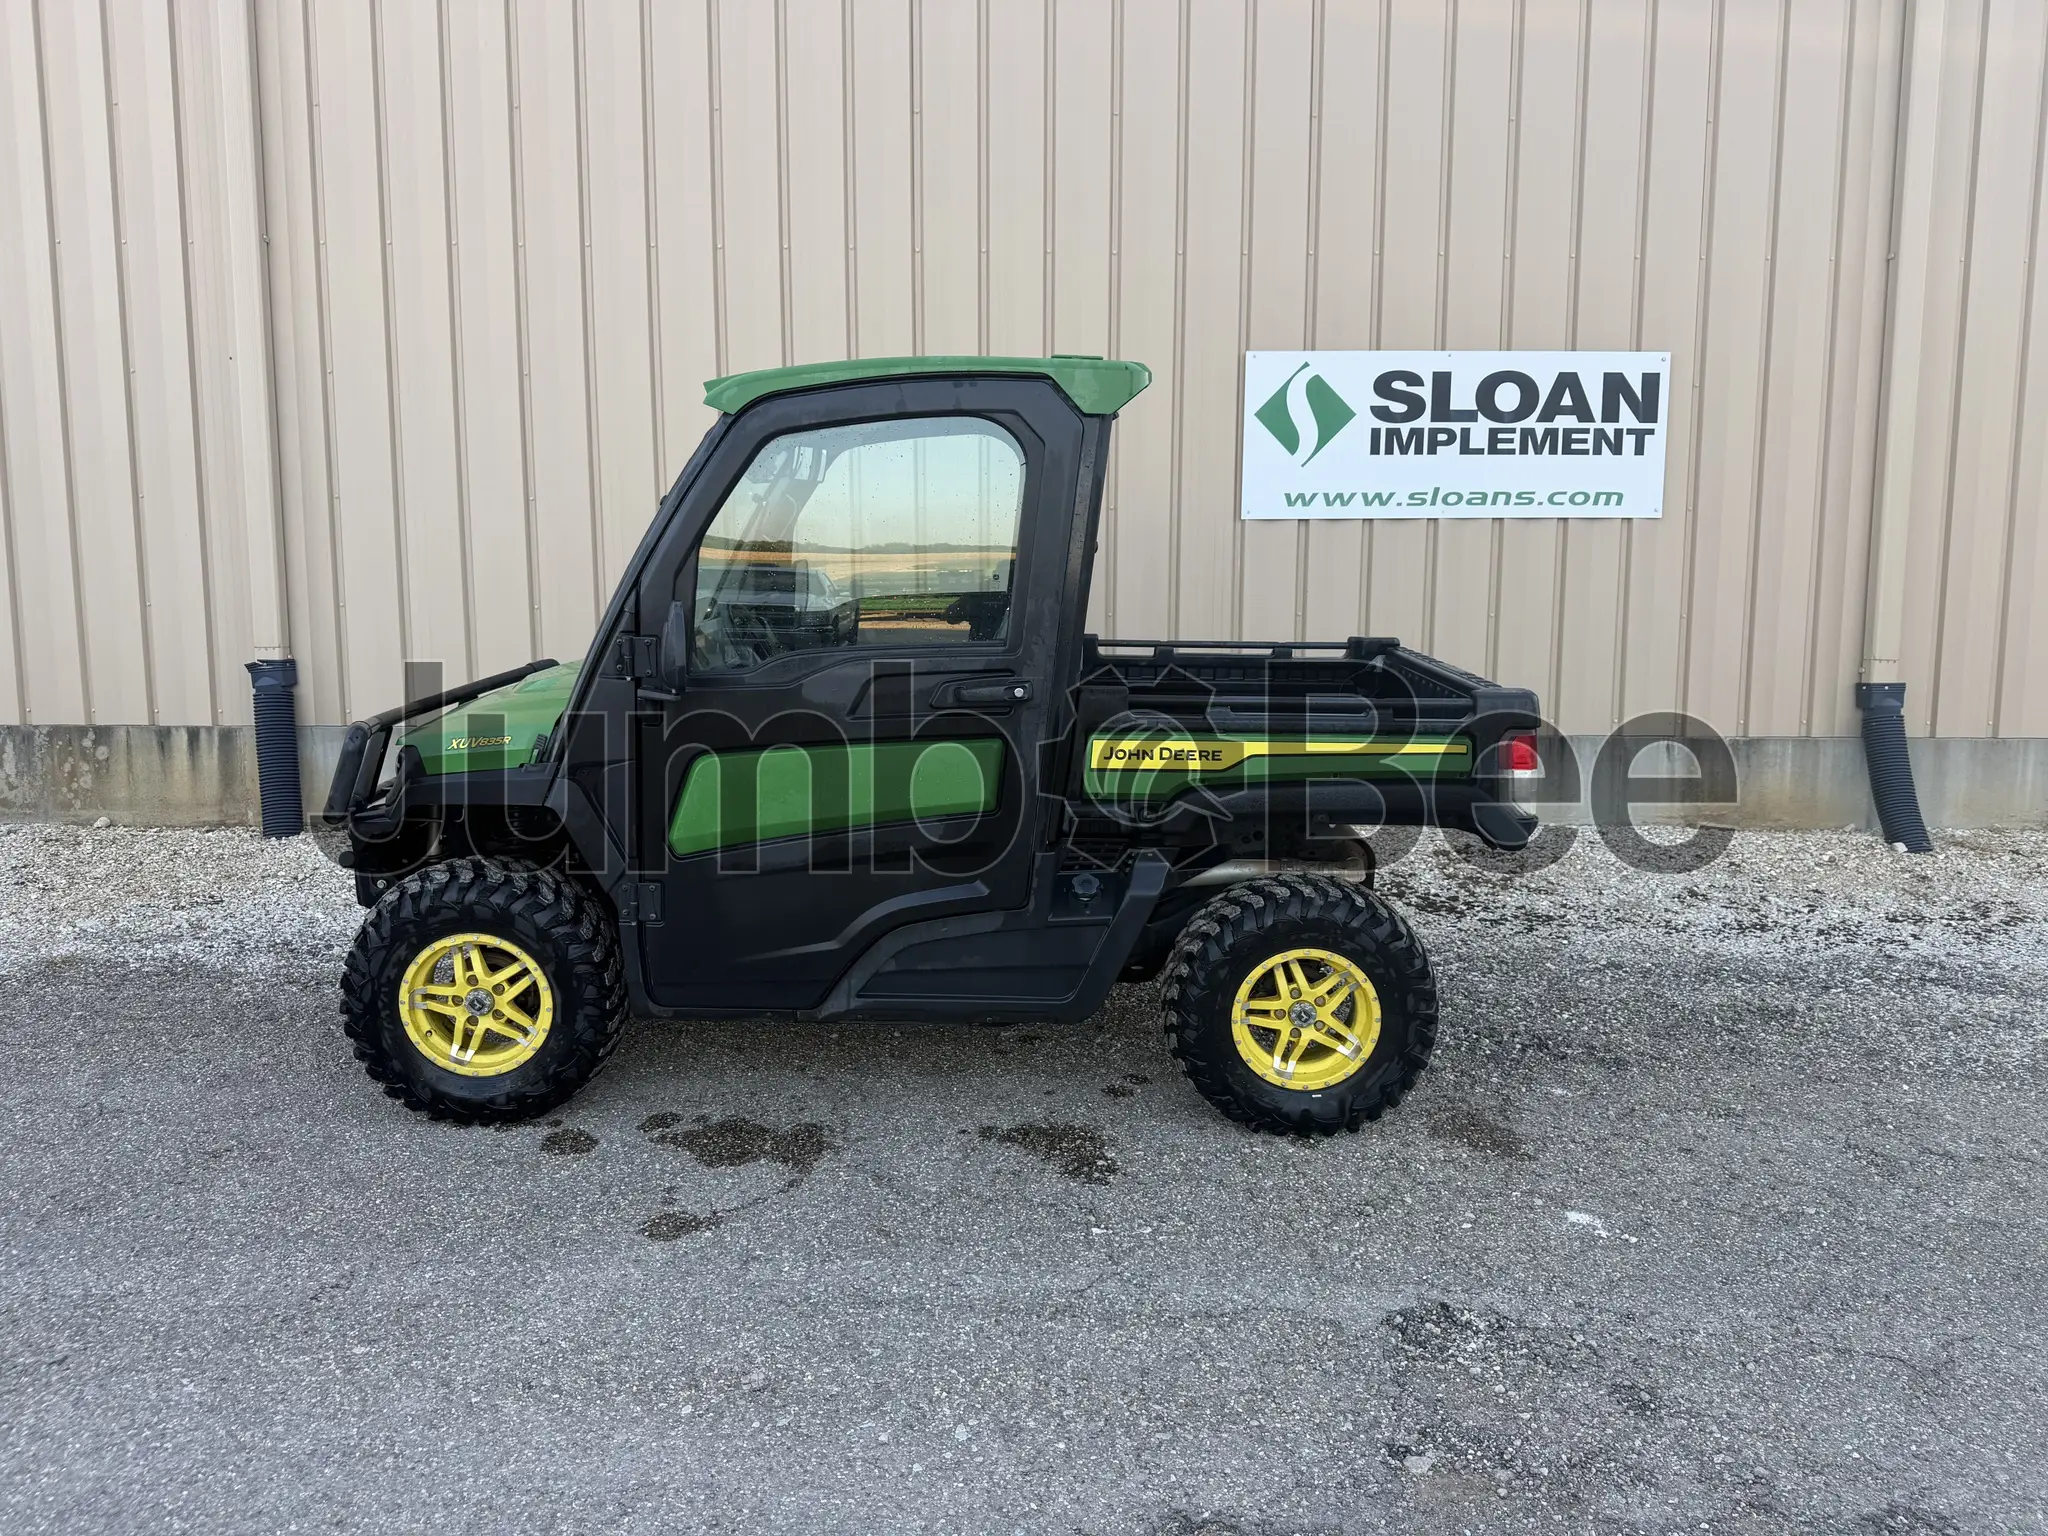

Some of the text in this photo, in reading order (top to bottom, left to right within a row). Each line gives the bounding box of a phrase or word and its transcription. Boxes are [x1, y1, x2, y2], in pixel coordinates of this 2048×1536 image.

[1370, 370, 1660, 424] SLOAN
[1370, 427, 1655, 456] IMPLEMENT
[1284, 487, 1624, 507] www.sloans.com
[446, 736, 512, 750] XUV835R
[1103, 746, 1223, 762] JOHN DEERE
